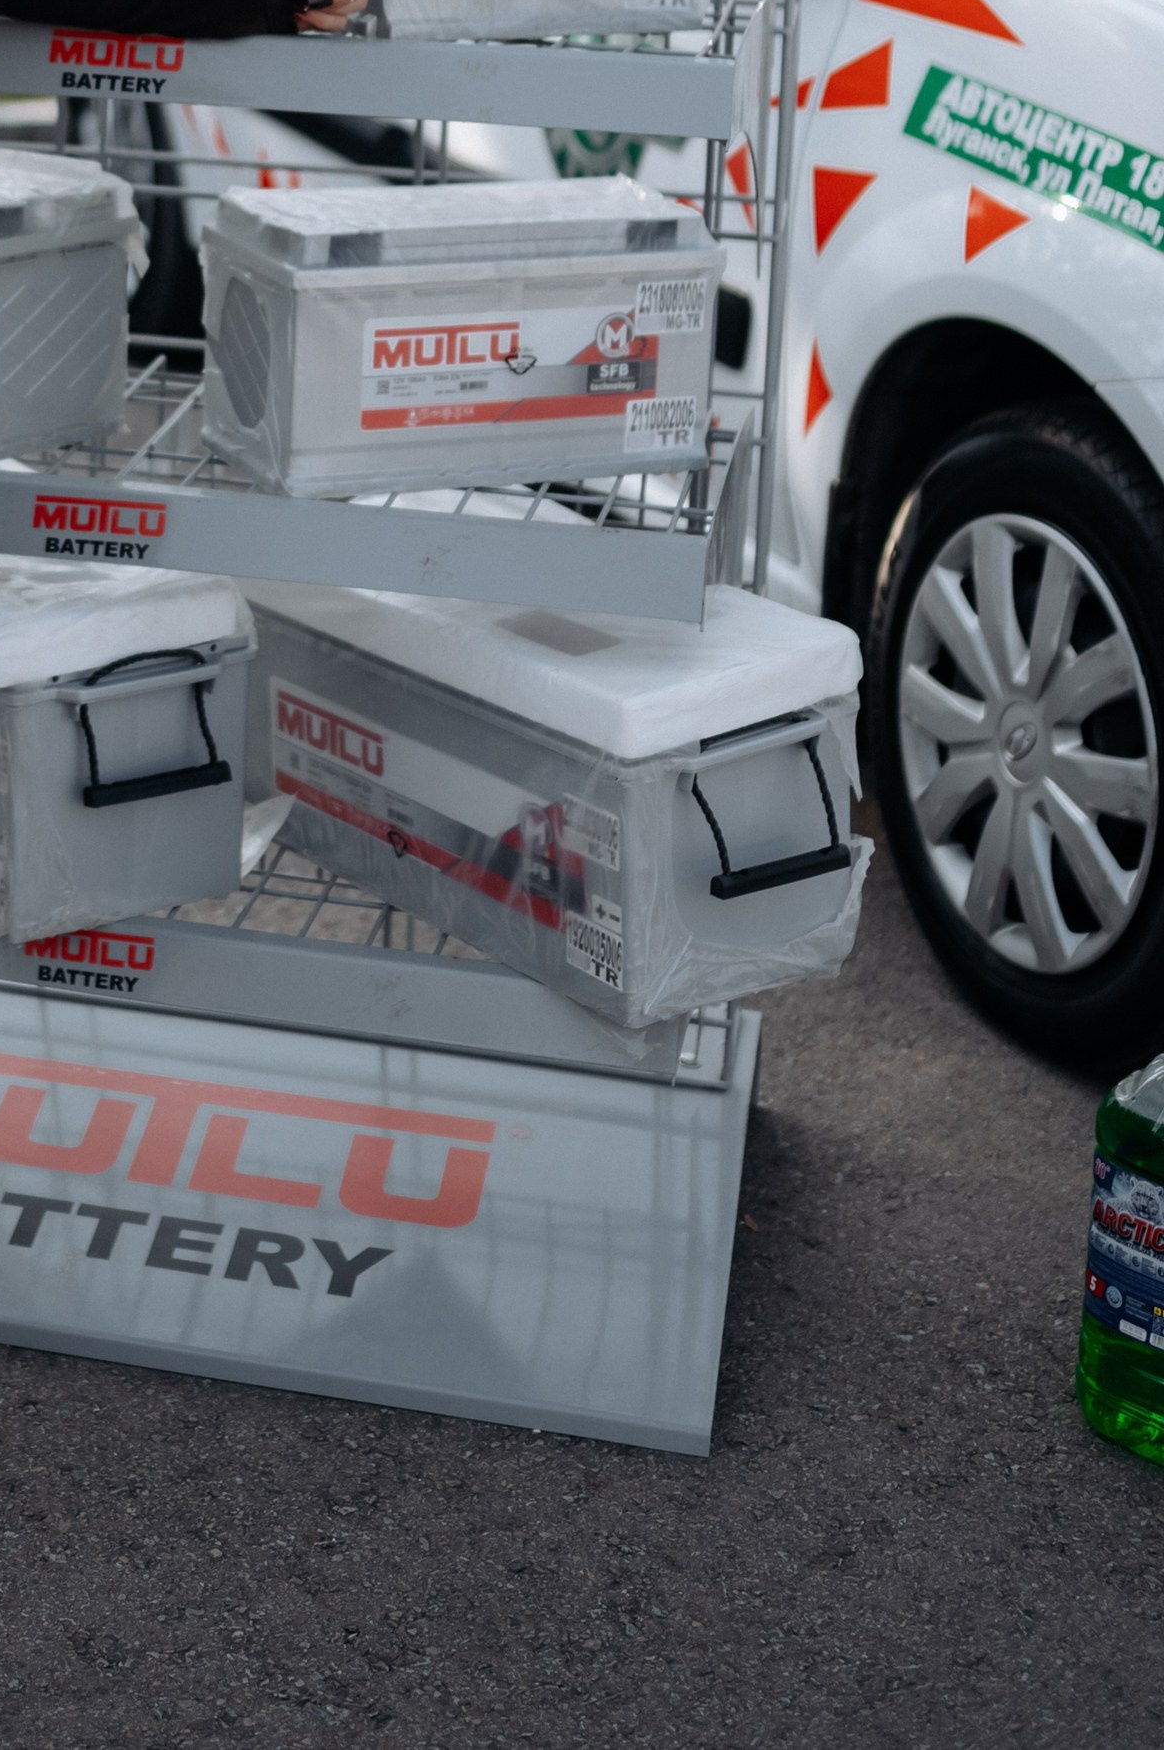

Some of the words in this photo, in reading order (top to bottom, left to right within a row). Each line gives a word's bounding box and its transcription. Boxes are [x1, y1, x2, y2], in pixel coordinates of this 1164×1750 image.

[49, 29, 185, 73] MUTLU
[61, 72, 167, 95] BATTERY
[922, 106, 1030, 184] Луганск,
[937, 75, 1125, 175] АВТОЦЕНТР
[373, 321, 521, 369] MUTLU
[600, 363, 629, 378] SFB
[658, 430, 690, 446] TR
[33, 494, 167, 538] MUTLU
[45, 537, 149, 560] BATTERY
[277, 689, 384, 778] MUTLU
[25, 930, 155, 971] MUTLU
[38, 965, 140, 993] BATTERY
[591, 958, 619, 988] TR
